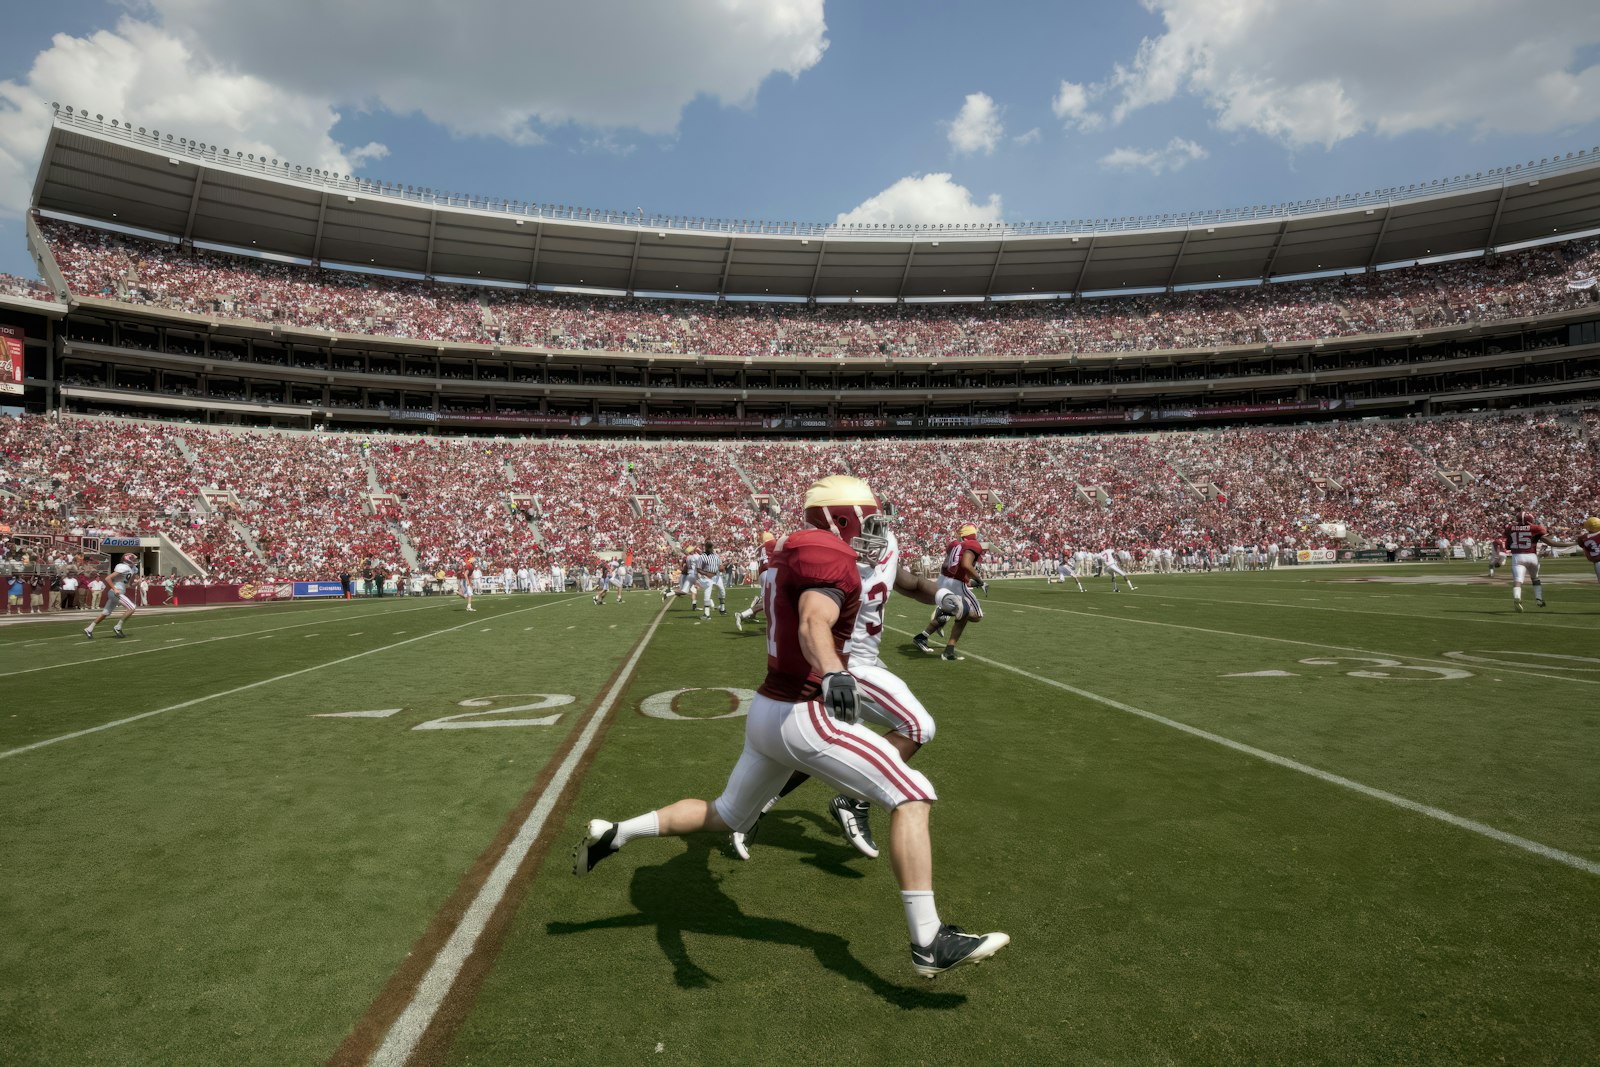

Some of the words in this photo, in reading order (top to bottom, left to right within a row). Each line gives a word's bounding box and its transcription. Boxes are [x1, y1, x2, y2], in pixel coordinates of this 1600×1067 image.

[1510, 531, 1532, 550] 15
[866, 581, 888, 636] 3
[411, 687, 758, 731] 20
